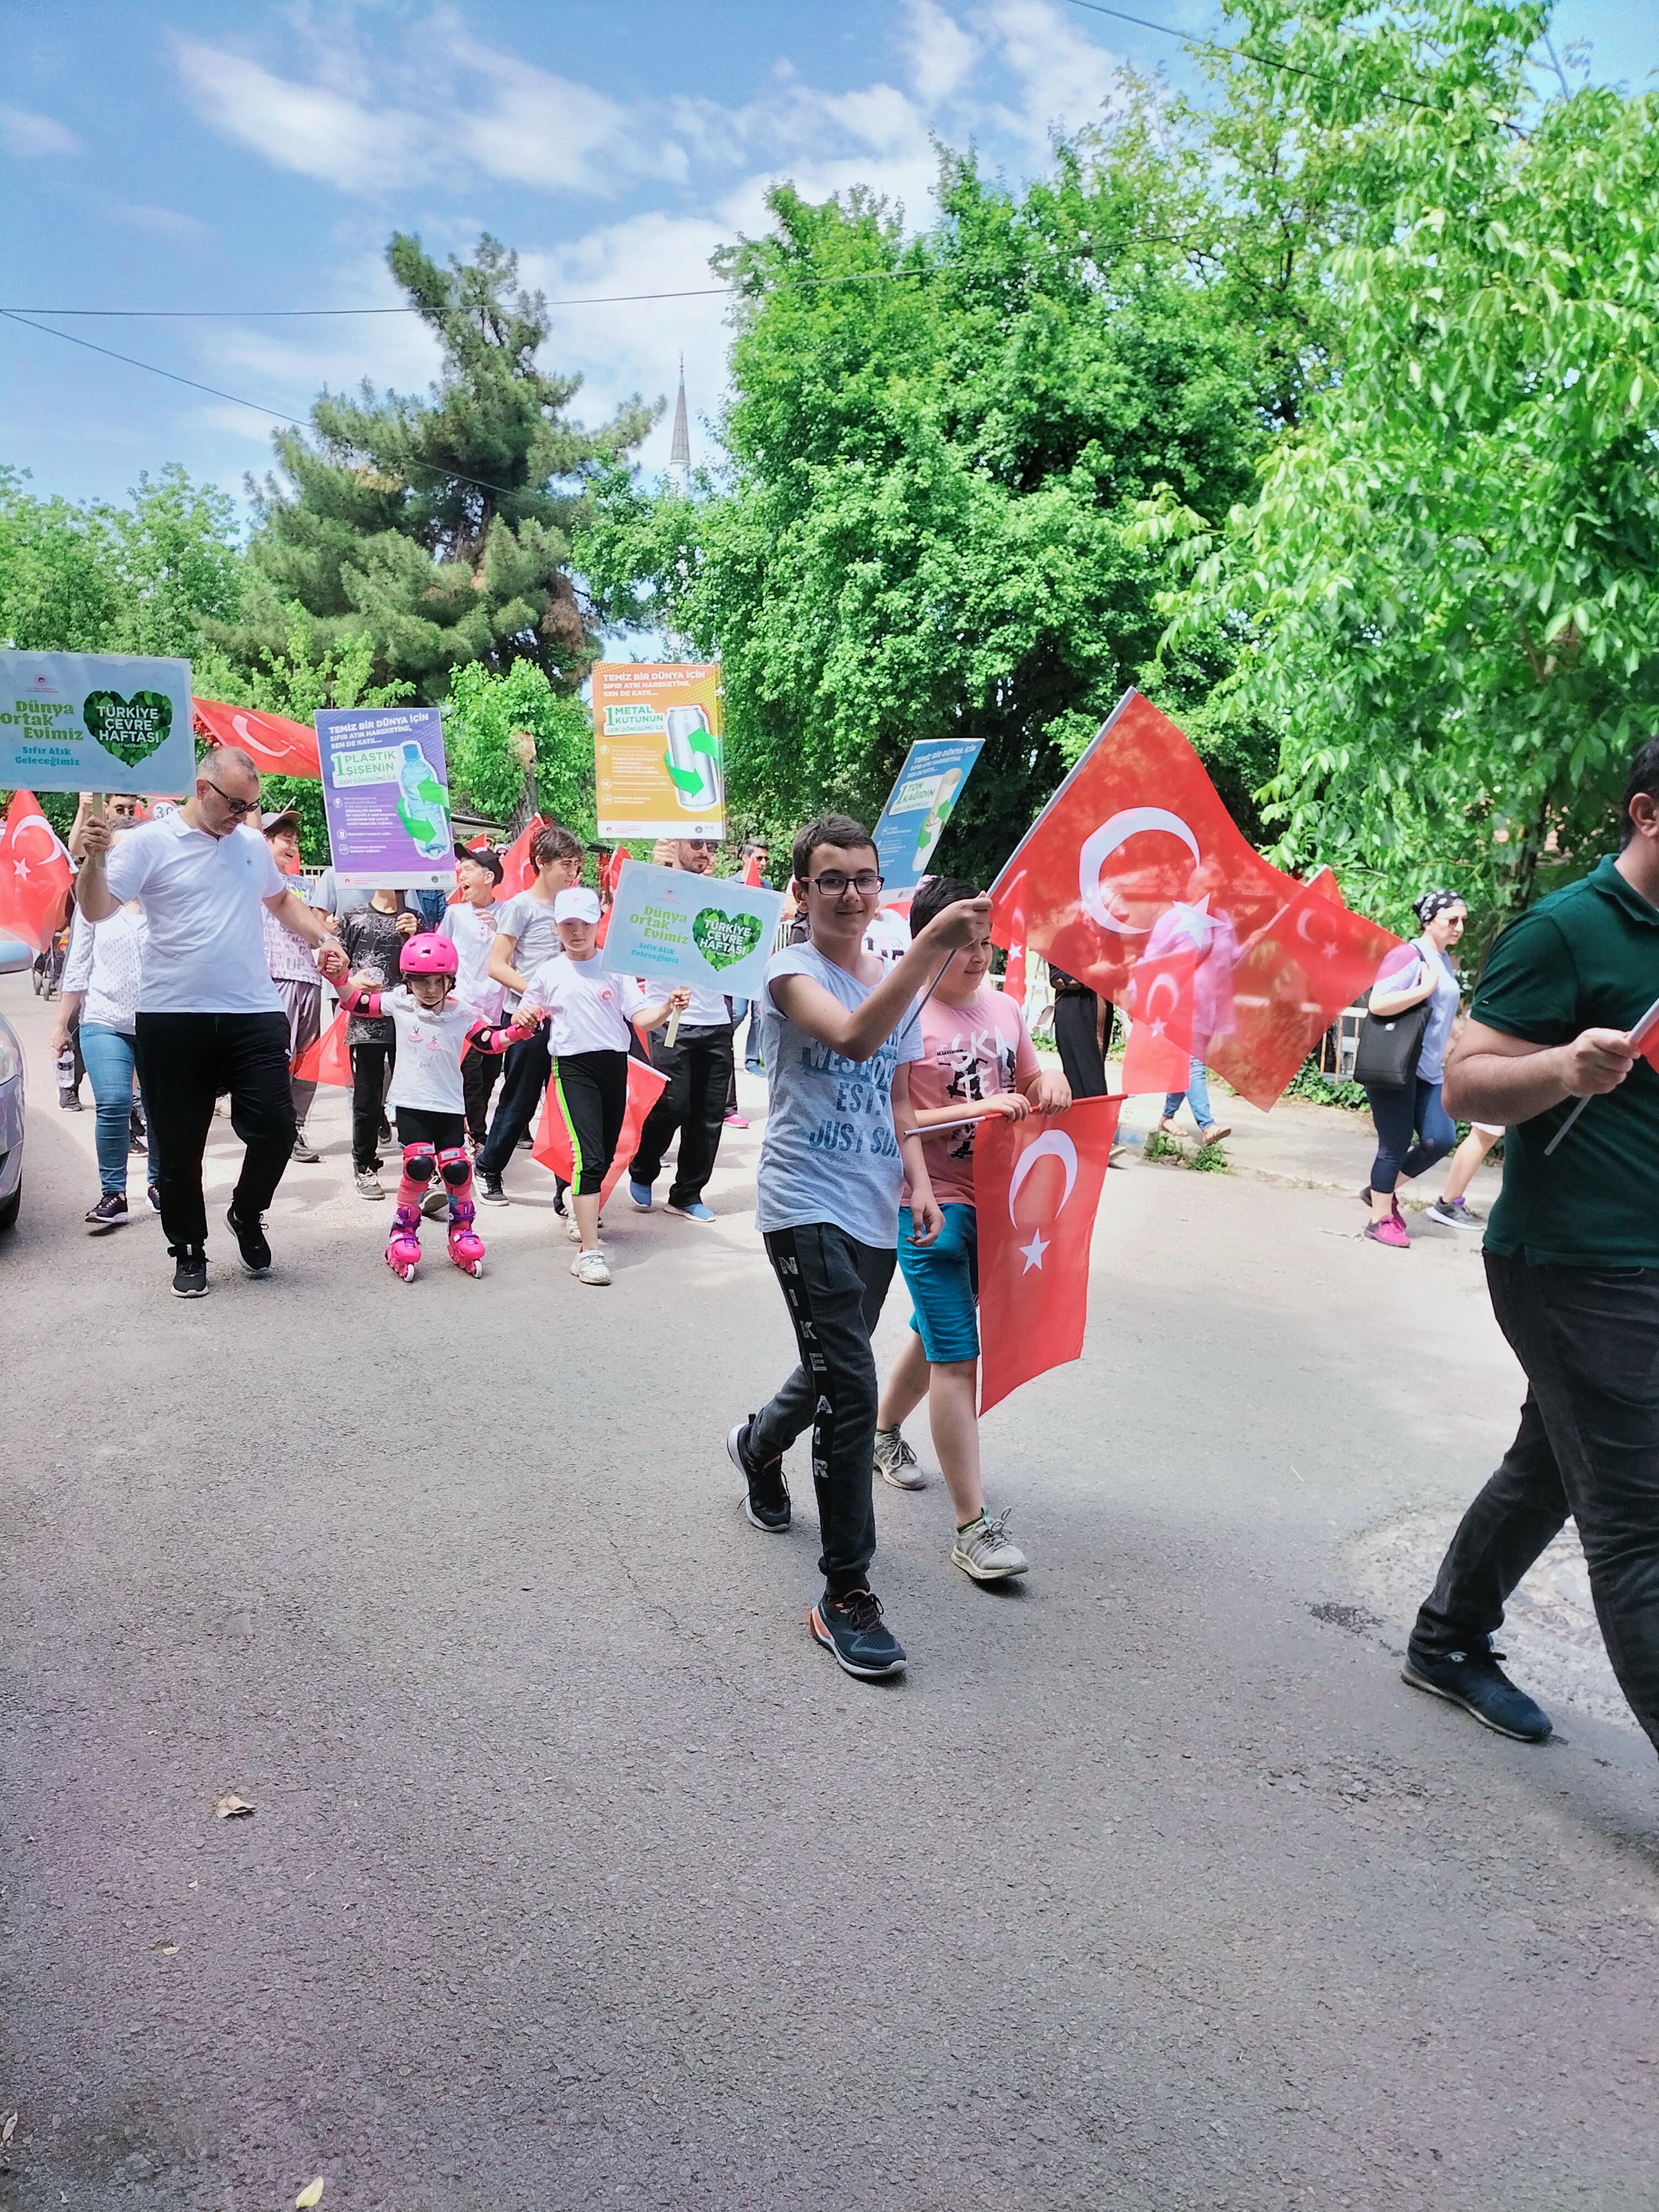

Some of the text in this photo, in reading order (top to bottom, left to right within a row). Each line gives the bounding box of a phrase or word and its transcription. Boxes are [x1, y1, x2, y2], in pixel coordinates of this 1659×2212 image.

[603, 670, 706, 682] TEMİZ BİR DÜNYA İÇİN
[15, 700, 74, 717] Dünya
[96, 703, 159, 719] TÜRKİYE
[606, 706, 653, 726] 1 METAL
[0, 712, 54, 726] Ortak
[105, 718, 153, 731] ÇEVRE
[328, 713, 429, 734] TEMİZ BİR DÜNYA İÇİN
[615, 714, 663, 724] KUTUNUN
[23, 727, 84, 740] Evimiz
[99, 729, 159, 743] HAFTASI
[330, 733, 348, 742] SIFIR
[366, 725, 412, 737] HAREKETİNE,
[622, 724, 654, 733] DÖNÜŞÜMÜ
[22, 747, 71, 755] Sıfır Atık
[15, 756, 80, 767] Geleceğimiz
[334, 750, 397, 776] 1 PLASTİK
[346, 762, 394, 776] ŞİŞENİN
[353, 775, 387, 784] DÖNÜŞÜMÜ
[895, 781, 925, 805] 1 TON
[902, 789, 936, 802] KAĞIDIN
[630, 914, 670, 930] Ortak
[644, 906, 687, 924] Dünya
[705, 919, 752, 937] TÜRKİYE
[644, 927, 688, 945] Evimiz
[707, 930, 744, 945] ÇEVRE
[639, 942, 675, 954] Sıfır Atık
[700, 938, 746, 955] HAFTASI
[631, 949, 679, 964] Geleceğimiz
[951, 1025, 1009, 1072] SKA
[809, 1119, 864, 1153] JUST
[778, 1257, 833, 1478] NIKE AIR
